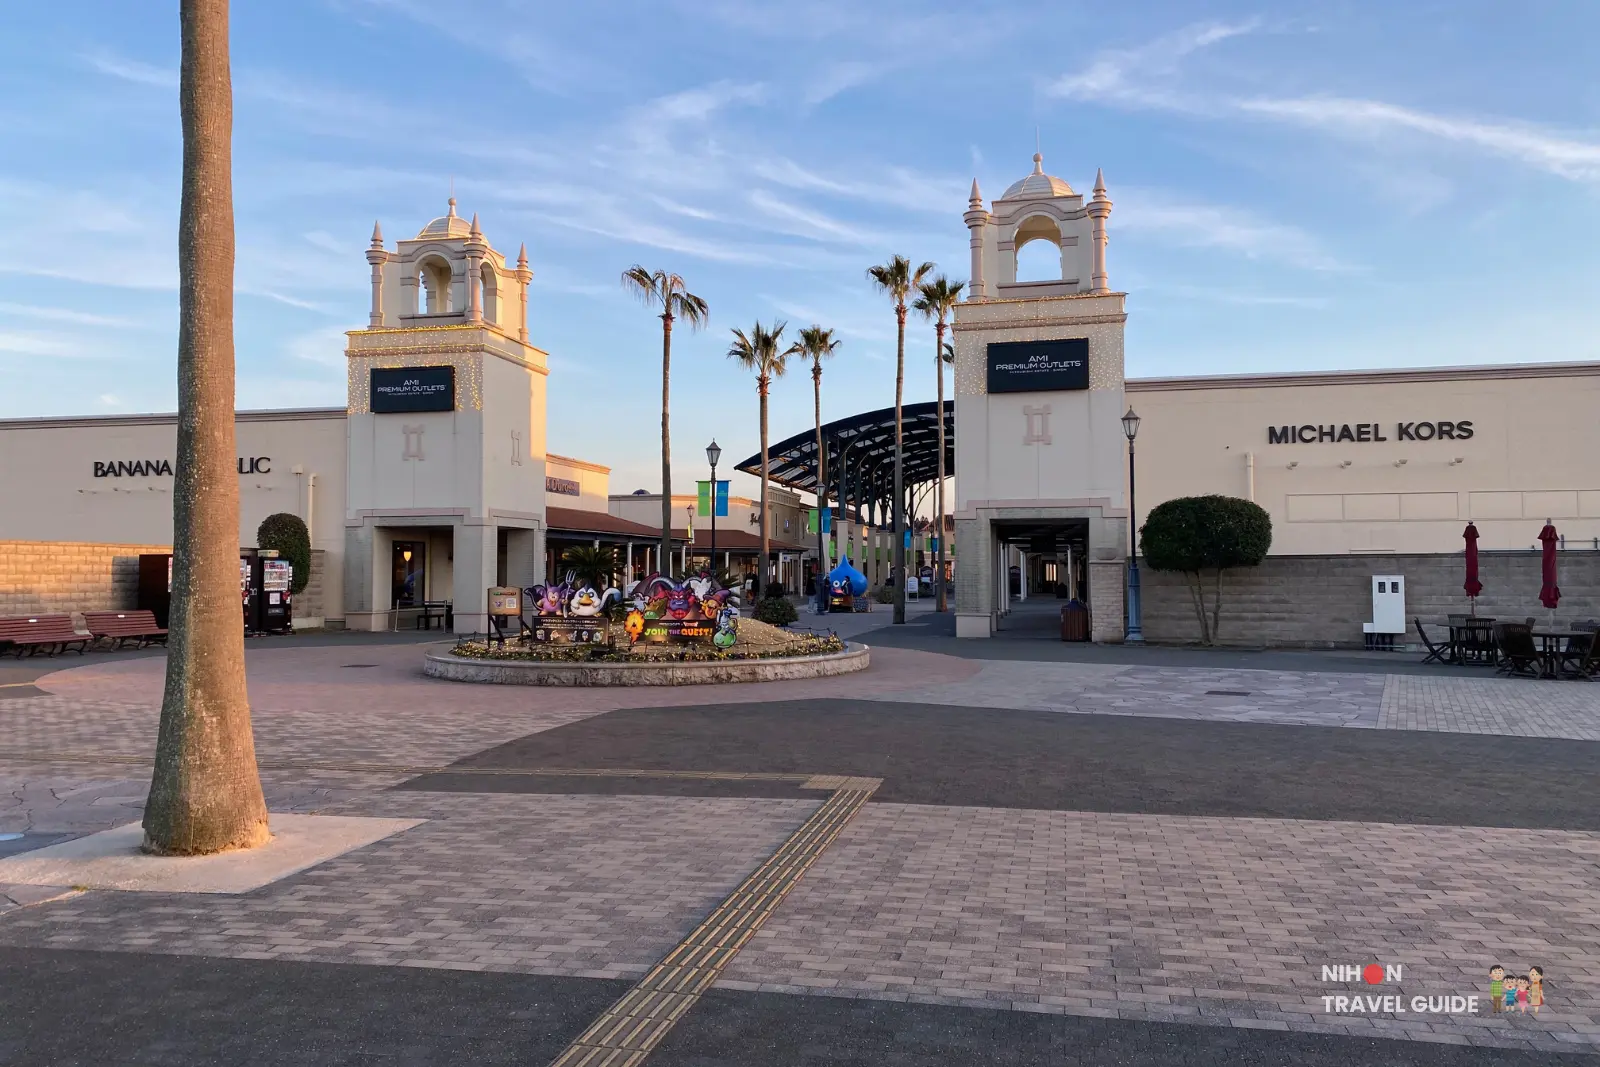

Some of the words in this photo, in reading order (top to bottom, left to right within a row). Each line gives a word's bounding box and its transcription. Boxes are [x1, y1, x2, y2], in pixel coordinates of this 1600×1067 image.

[996, 362, 1038, 371] PREMIUM
[1039, 360, 1082, 369] OUTLETS
[377, 385, 411, 393] PREMIUM
[1267, 423, 1387, 445] MICHAEL
[1398, 420, 1474, 441] KORS
[93, 459, 173, 477] BANANA
[644, 628, 668, 636] JOIN
[681, 628, 713, 636] QUEST!
